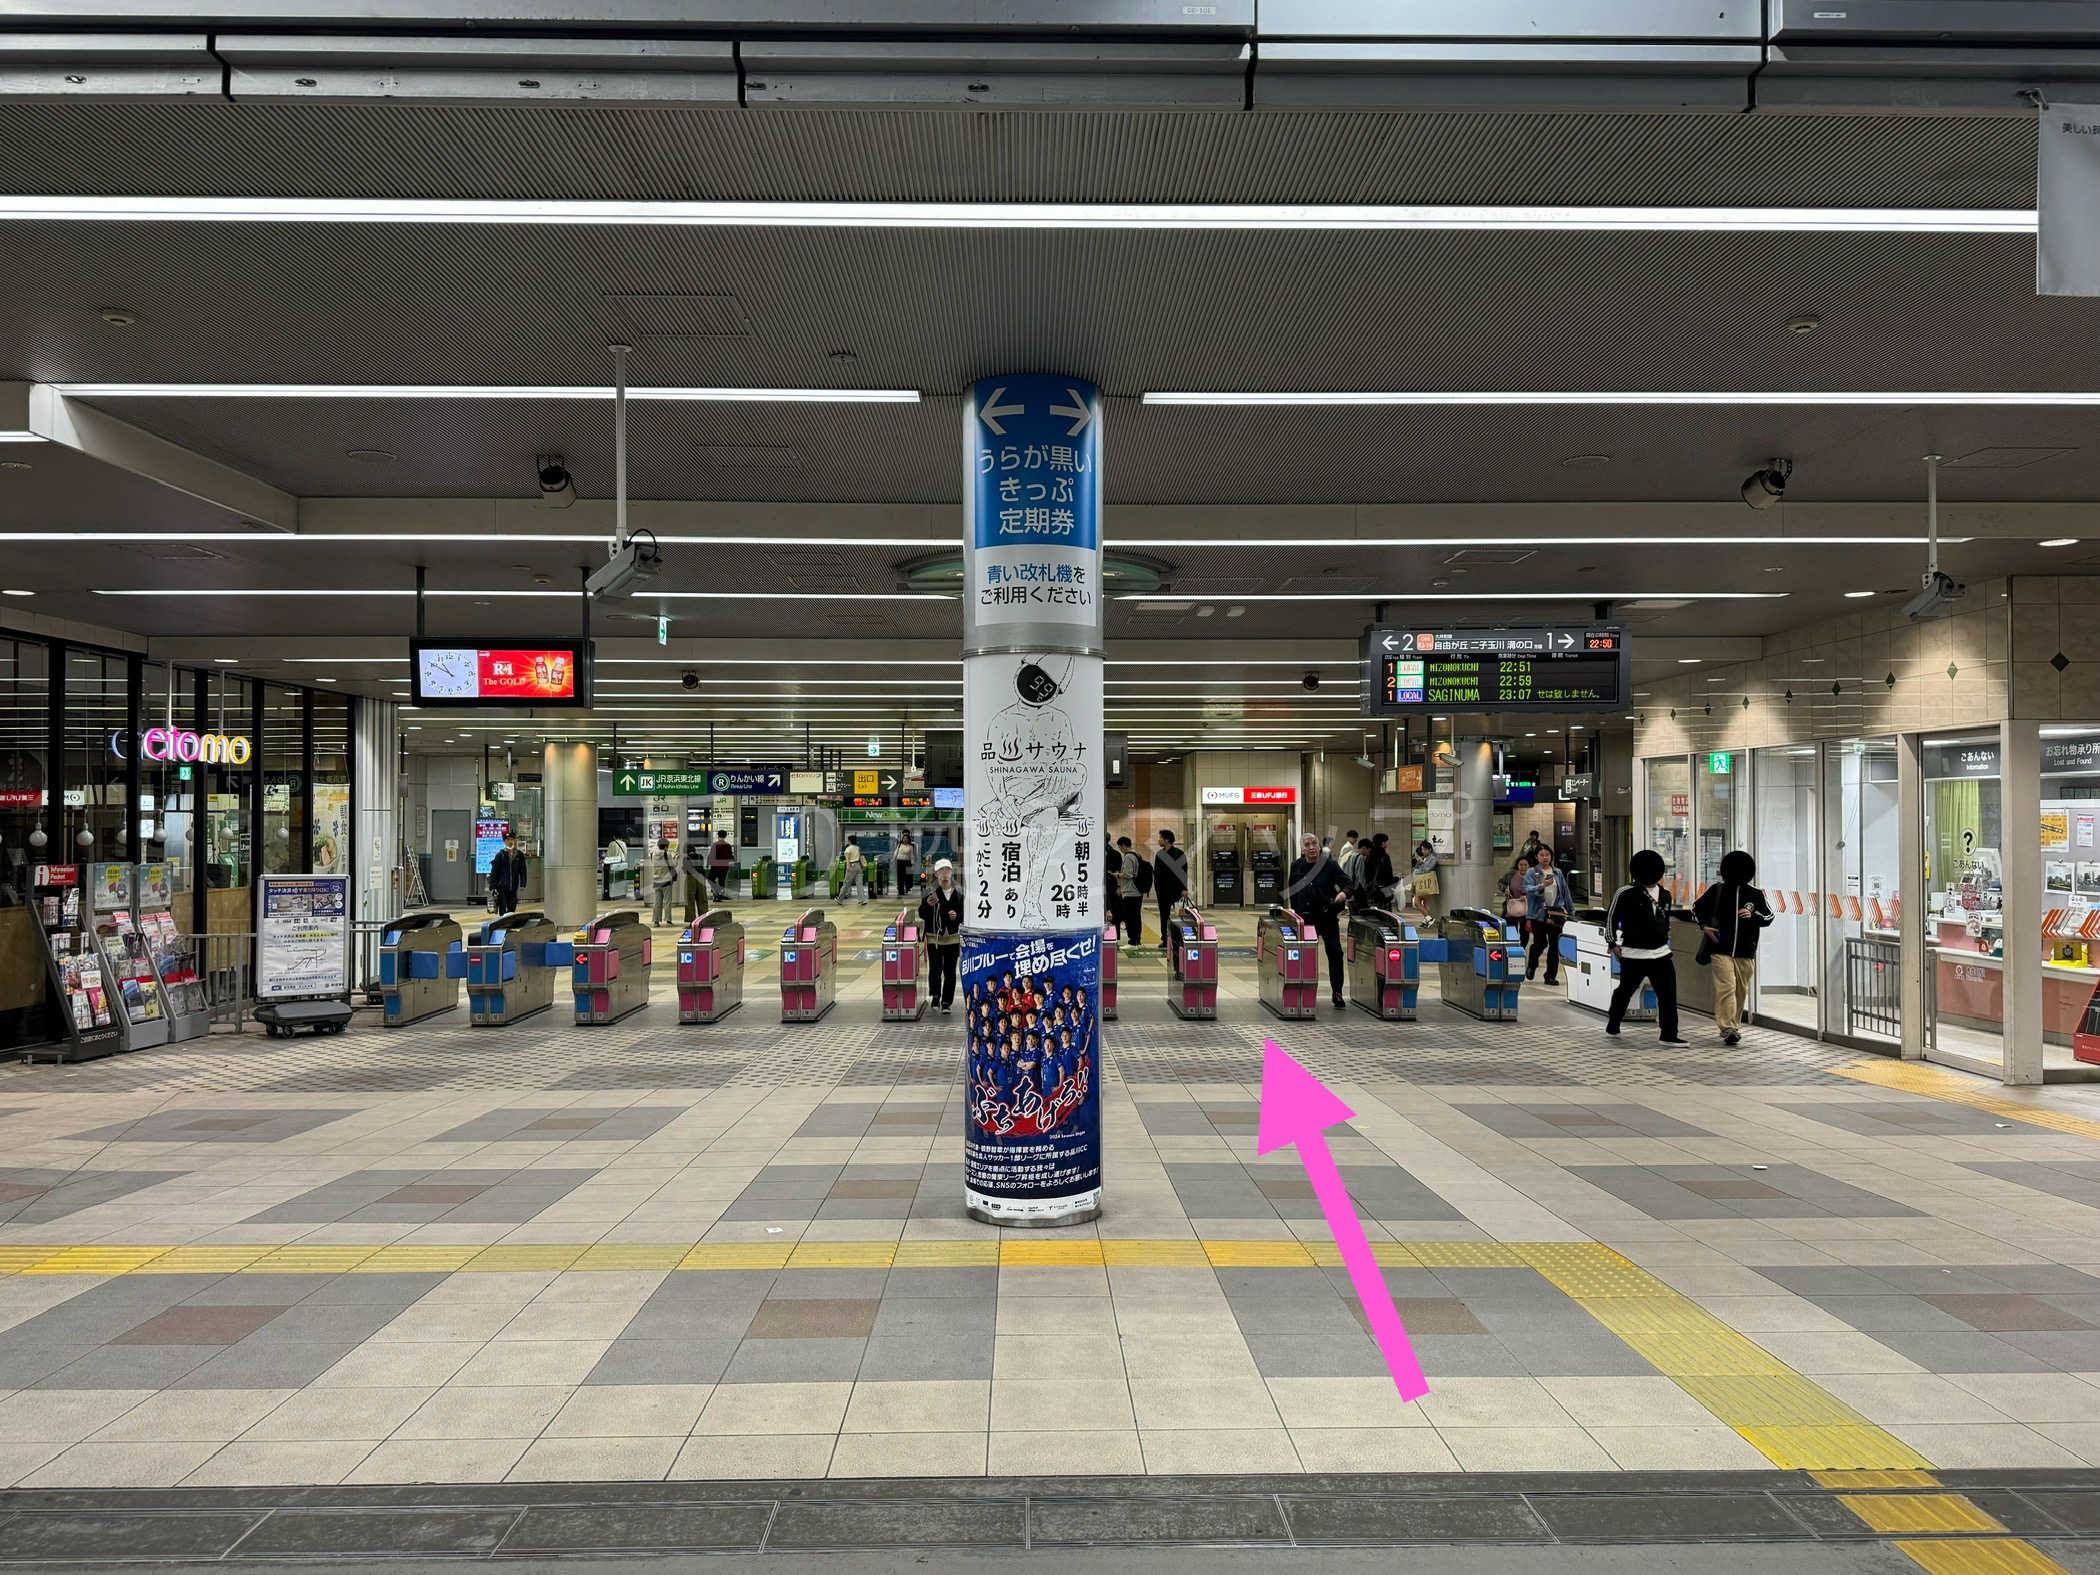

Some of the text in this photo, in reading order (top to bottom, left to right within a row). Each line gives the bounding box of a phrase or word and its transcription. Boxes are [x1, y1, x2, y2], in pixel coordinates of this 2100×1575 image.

[979, 444, 1092, 475] うらが黒い
[999, 476, 1074, 503] きっぷ
[999, 507, 1075, 536] 定期券
[987, 563, 1086, 584] 青い改札機を
[980, 586, 1092, 606] ご利用ください
[1402, 633, 1414, 651] 2
[1434, 640, 1468, 650] 自由が丘
[1470, 640, 1505, 650] 二子玉川
[1546, 632, 1552, 650] 1
[1589, 638, 1613, 648] 22:50
[1388, 662, 1393, 674] 1
[1429, 662, 1479, 672] MIZONOKUCHI
[1499, 662, 1531, 672] 22:51
[483, 677, 526, 686] The GOLD
[1387, 676, 1396, 688] 2
[1429, 676, 1479, 686] MIZONOKUCHI
[1499, 675, 1532, 686] 22:59
[1388, 689, 1601, 702] 1 LOCAL SAGINUMA 23:07 せは致しません。
[143, 724, 251, 765] etomo
[2045, 742, 2100, 757] お忘れ物承り所
[1960, 751, 1995, 762] ごあんない
[989, 766, 1078, 774] SHINAGAWA SAUNA
[641, 777, 652, 787] JK
[656, 773, 702, 784] JR京浜東北線
[730, 774, 765, 784] りんかい線
[858, 774, 875, 783] 出口
[866, 811, 901, 819] NewDays
[50, 866, 75, 874] Information
[1952, 860, 1985, 870] ごあんない
[1002, 841, 1022, 919] 宿泊あり
[680, 952, 692, 964] IC
[784, 952, 796, 962] IC
[886, 950, 898, 962] IC
[1187, 950, 1199, 960] IC
[1287, 950, 1299, 960] IC
